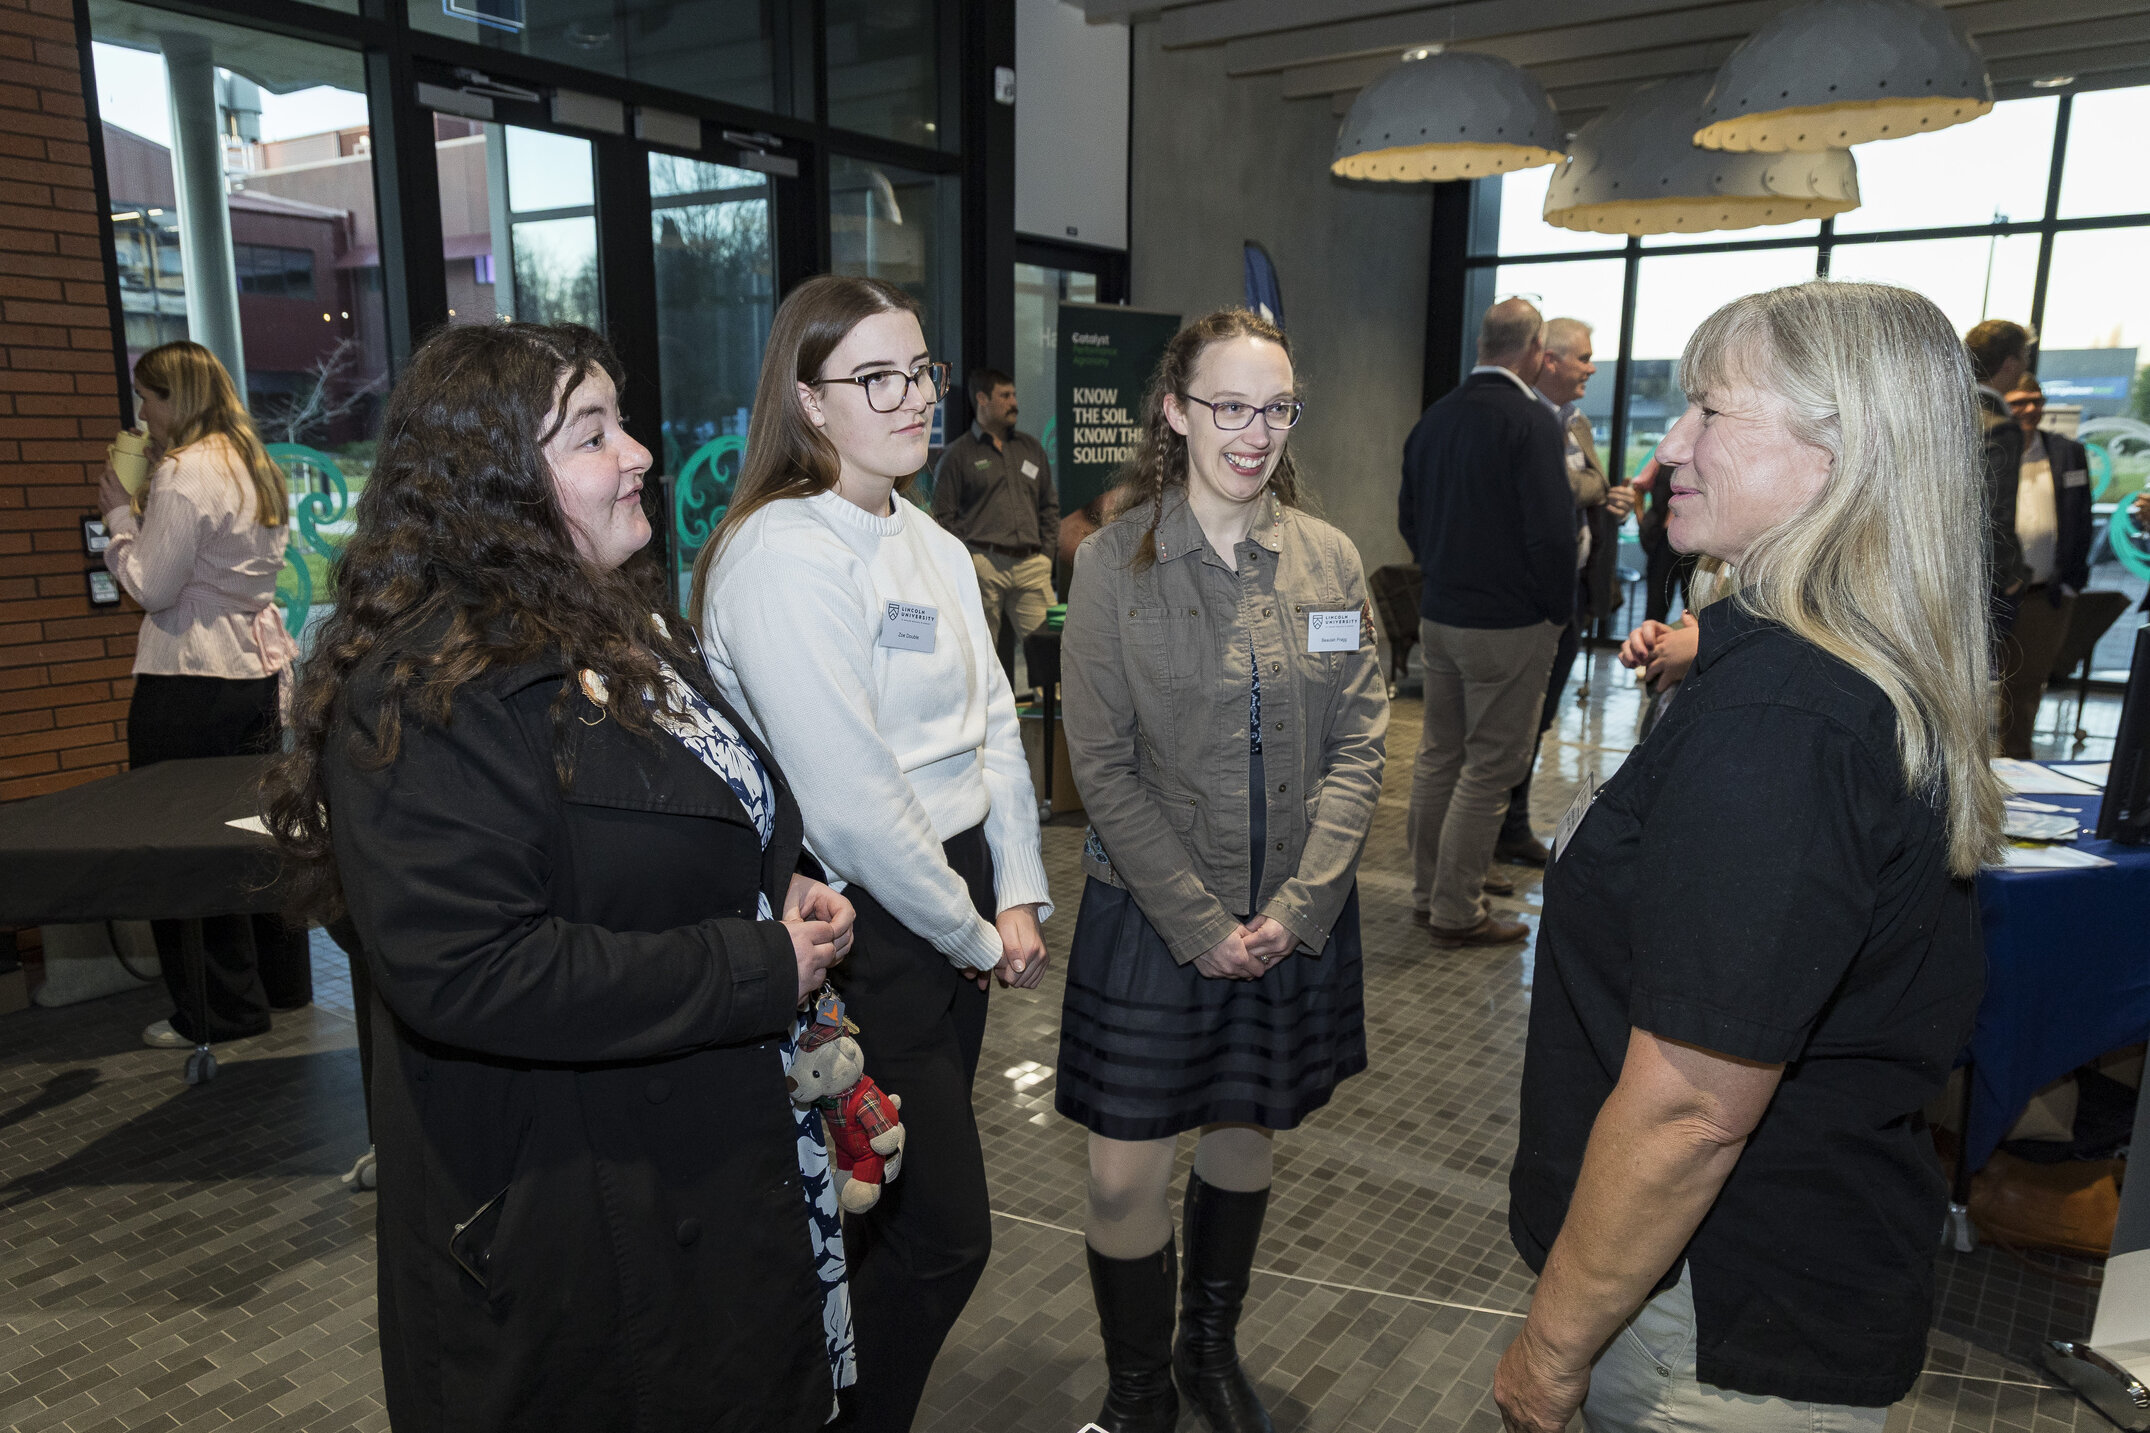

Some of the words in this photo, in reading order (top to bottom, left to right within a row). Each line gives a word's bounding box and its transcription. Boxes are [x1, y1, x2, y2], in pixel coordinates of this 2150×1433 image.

[1071, 332, 1110, 347] Catalyst
[1073, 387, 1118, 405] KNOW
[1073, 407, 1100, 424] THE
[1101, 407, 1134, 425] SOIL.
[1073, 427, 1118, 444] KNOW
[901, 606, 926, 615] LINCOLN
[901, 611, 935, 622] UNIVERSITY
